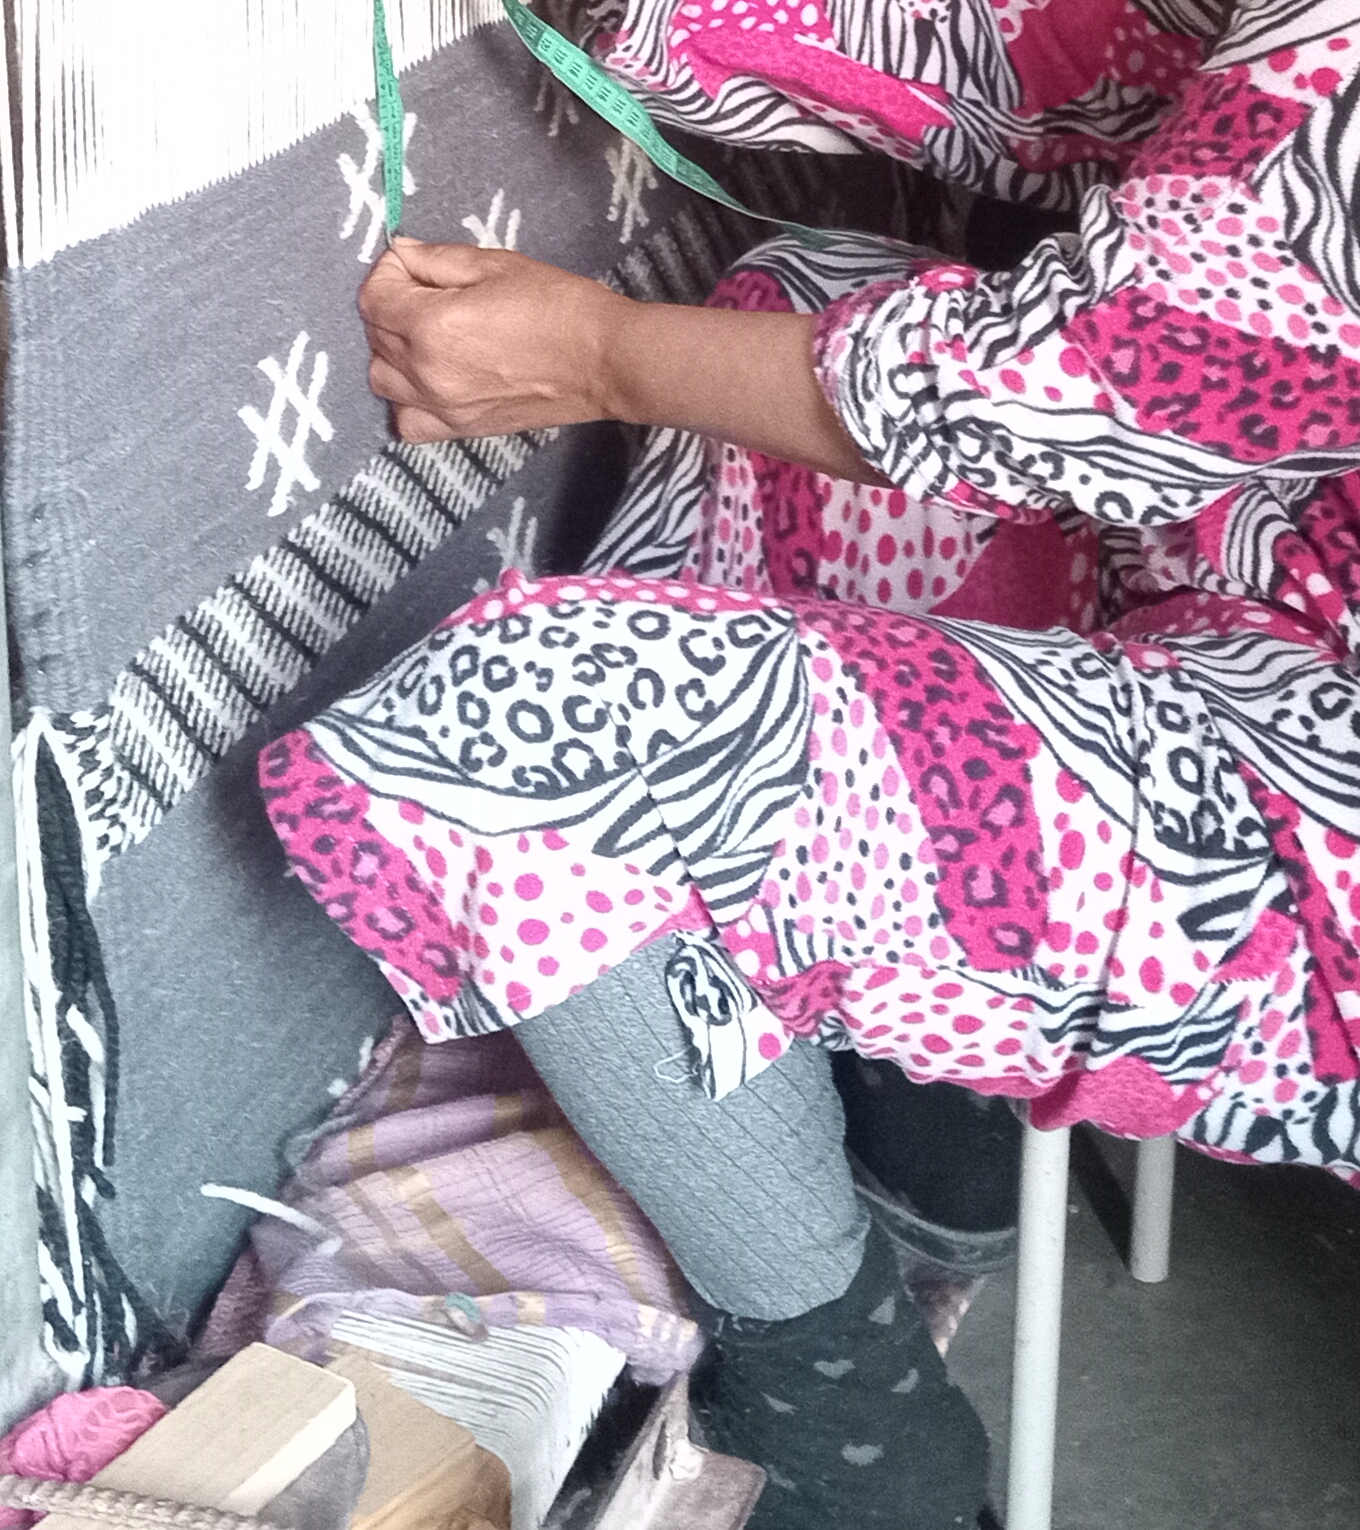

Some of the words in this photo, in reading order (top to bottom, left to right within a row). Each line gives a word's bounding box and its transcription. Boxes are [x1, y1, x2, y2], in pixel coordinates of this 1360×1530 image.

[584, 73, 599, 90] 117
[597, 86, 612, 102] 116
[612, 99, 627, 114] 115
[627, 111, 640, 127] 114
